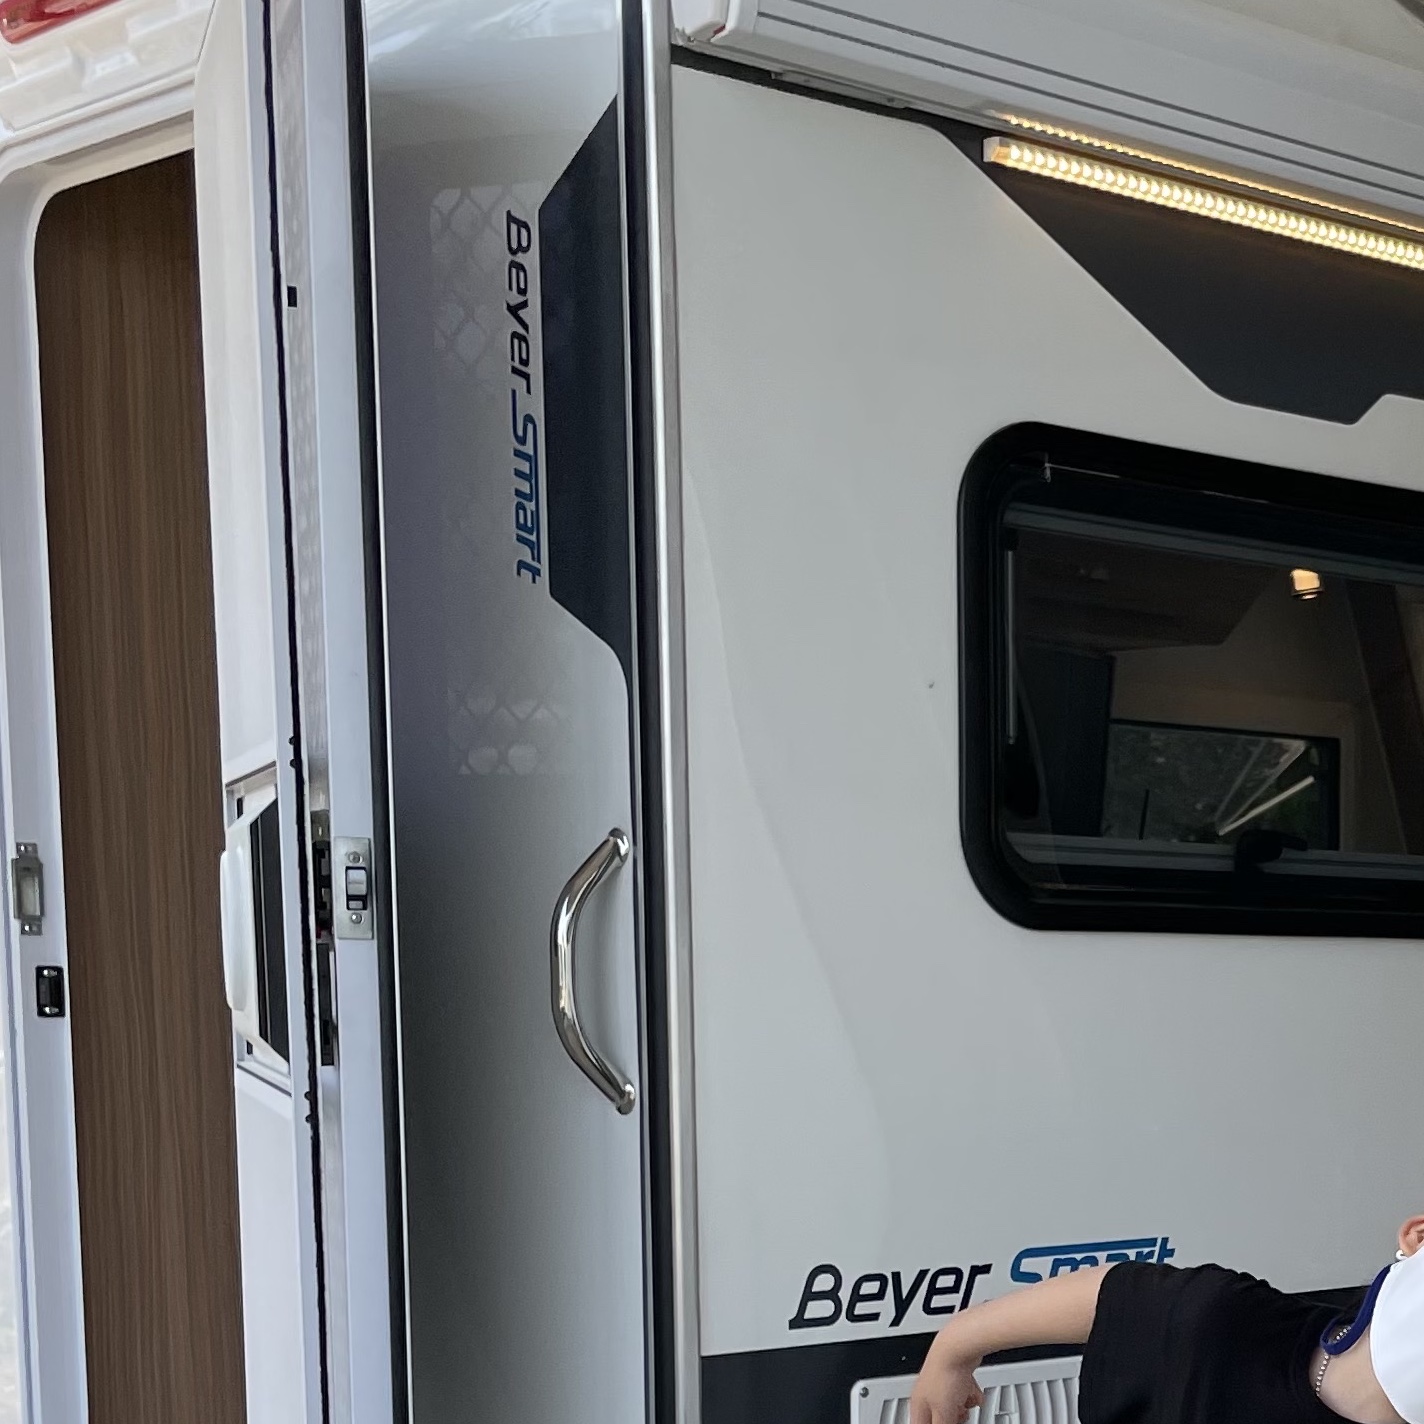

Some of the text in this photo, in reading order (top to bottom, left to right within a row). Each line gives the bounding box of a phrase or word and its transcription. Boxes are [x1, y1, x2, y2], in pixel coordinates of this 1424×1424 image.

[506, 210, 543, 584] Beyer Smart
[788, 1263, 993, 1330] Beyer
